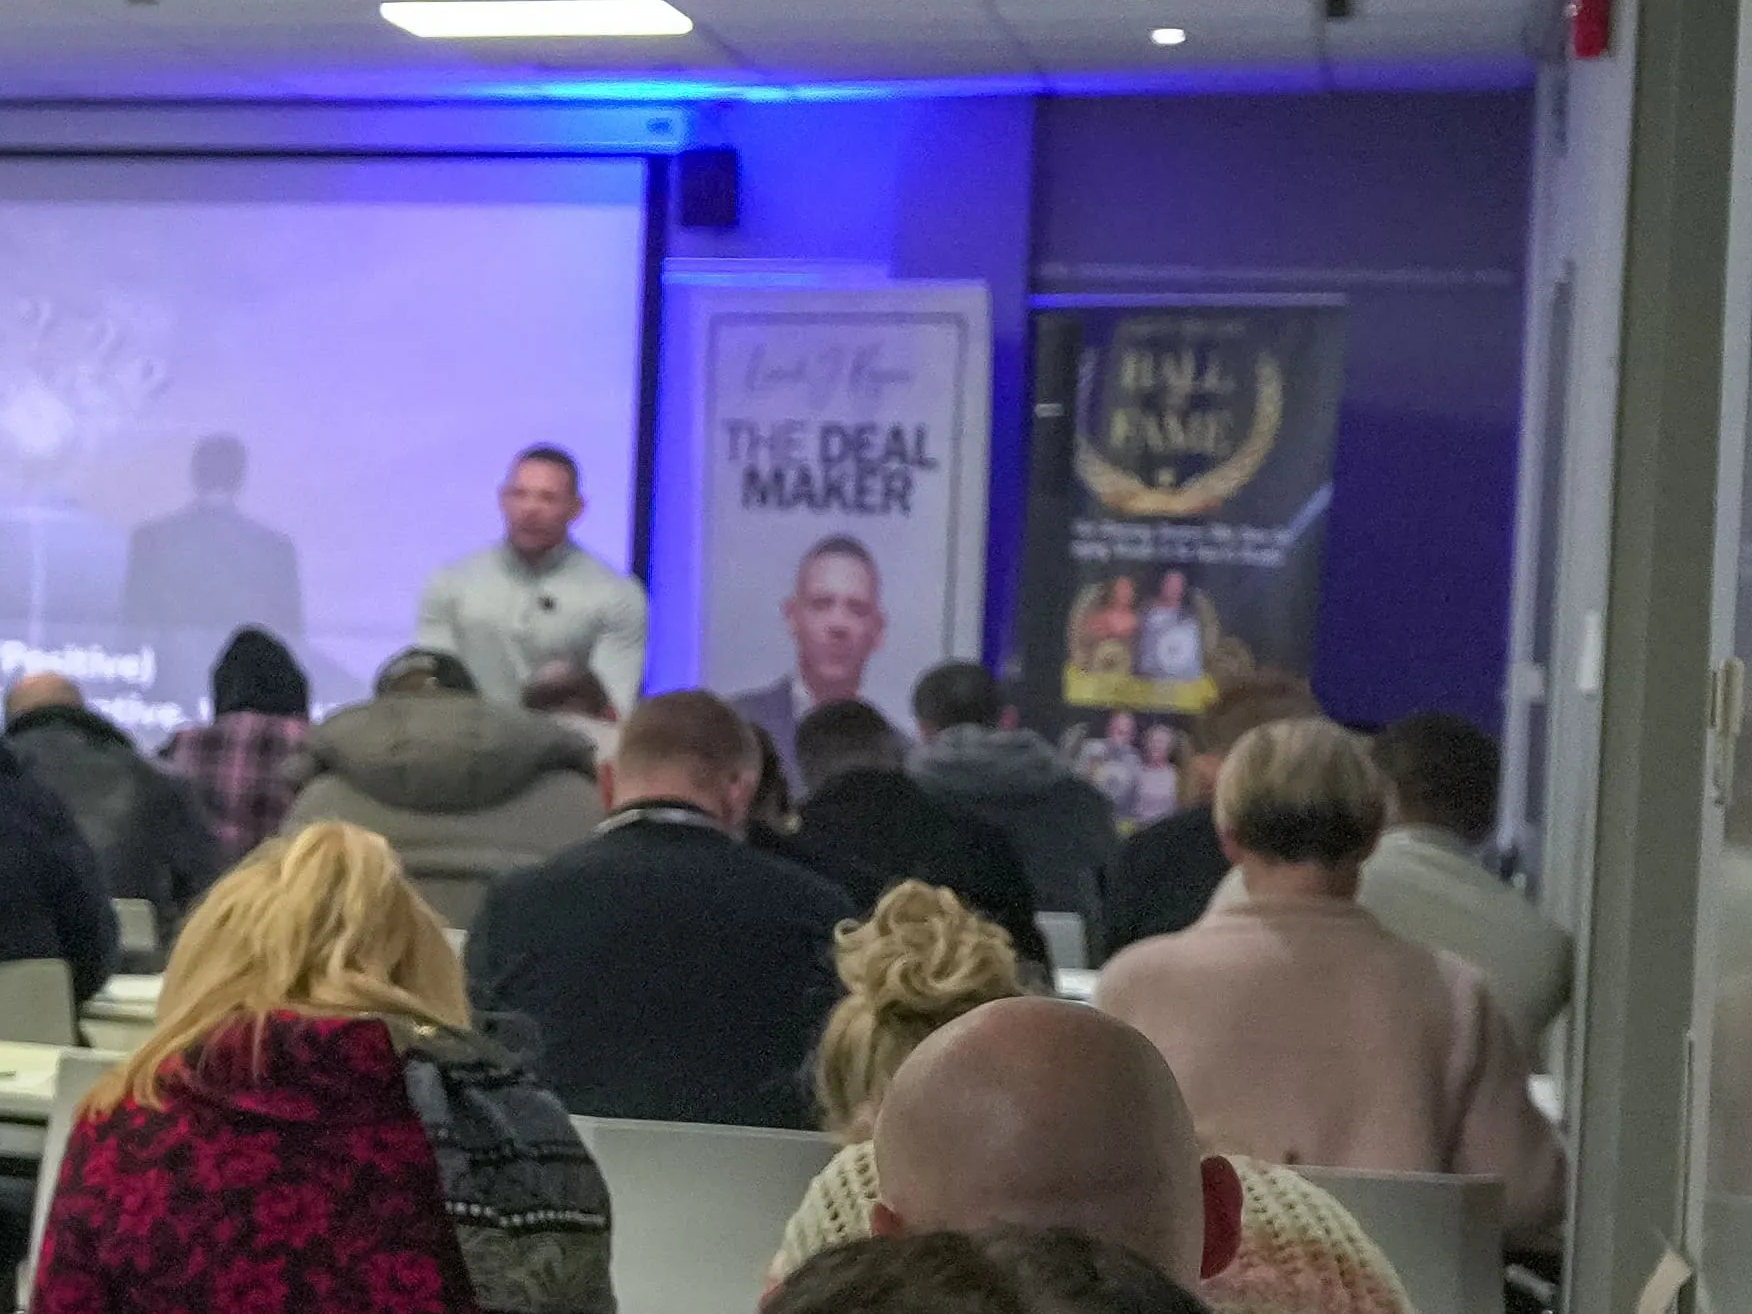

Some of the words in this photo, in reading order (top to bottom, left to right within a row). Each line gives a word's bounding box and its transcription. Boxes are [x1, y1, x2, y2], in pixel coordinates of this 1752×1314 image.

[722, 418, 807, 464] THE
[818, 421, 940, 470] DEAL
[742, 465, 916, 518] MAKER
